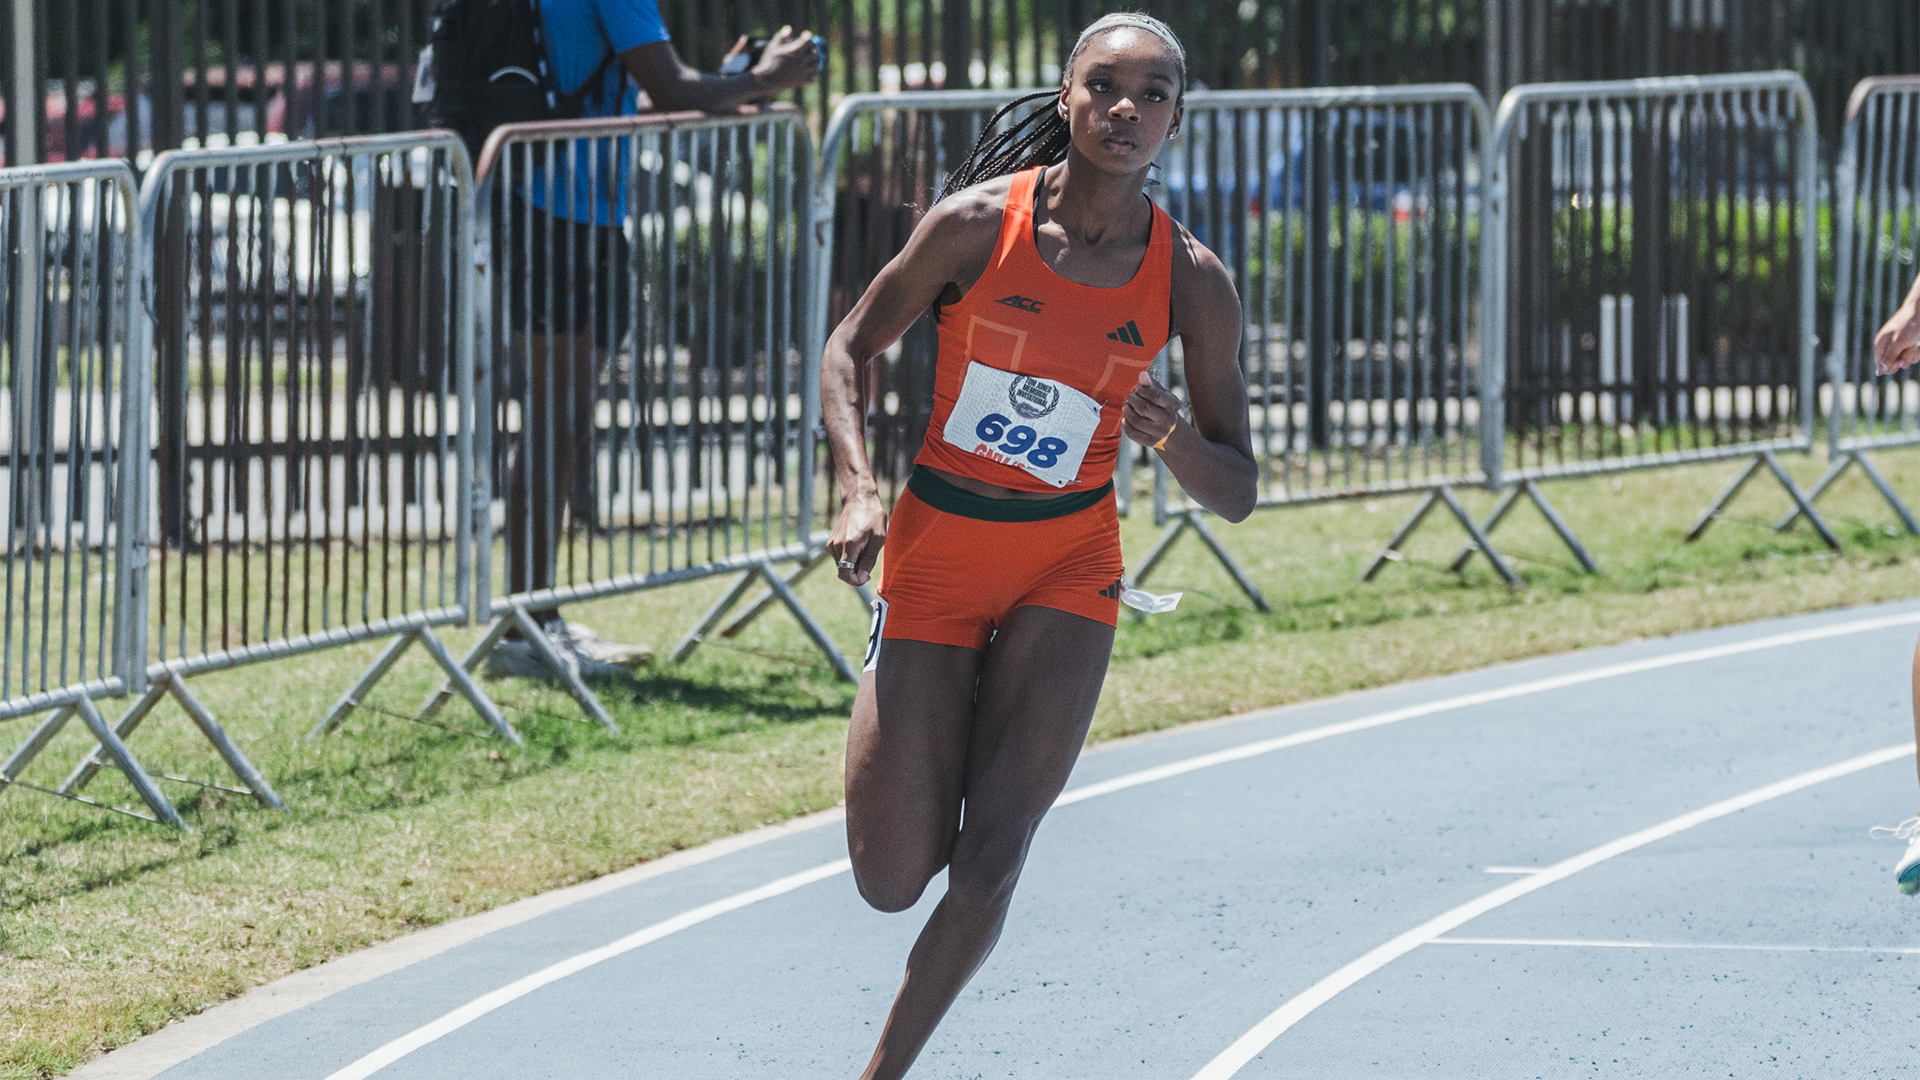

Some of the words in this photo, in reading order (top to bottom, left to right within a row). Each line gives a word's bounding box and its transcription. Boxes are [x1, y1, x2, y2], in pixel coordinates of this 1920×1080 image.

[995, 295, 1045, 314] ACC
[1022, 384, 1047, 399] MEMORIAL
[1025, 377, 1037, 386] TOM
[1036, 381, 1052, 393] JONES
[1016, 389, 1047, 407] INVITATIONAL
[975, 413, 1068, 468] 698
